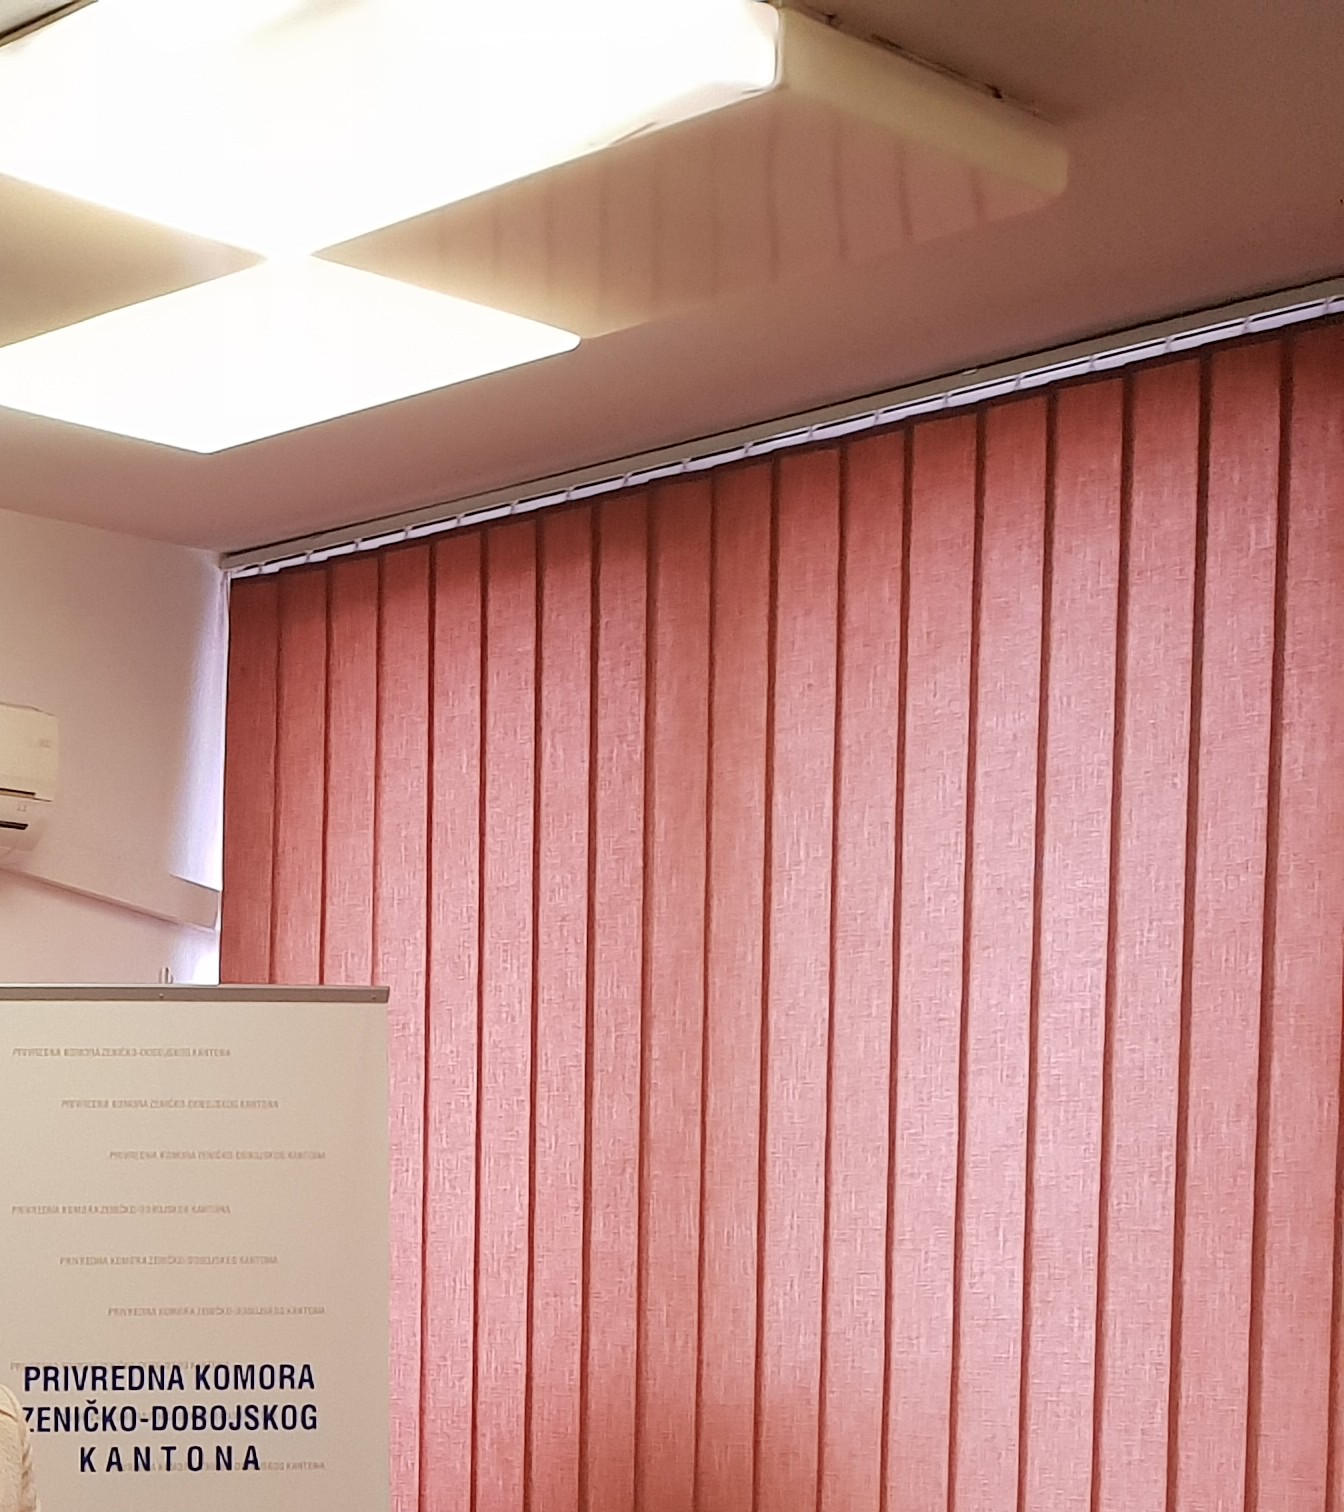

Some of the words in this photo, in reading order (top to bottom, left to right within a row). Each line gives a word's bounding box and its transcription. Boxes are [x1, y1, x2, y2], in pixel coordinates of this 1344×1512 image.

[24, 1364, 185, 1392] PRIVREDNA
[195, 1364, 315, 1391] KOMORA
[79, 1445, 261, 1472] KANTONA
